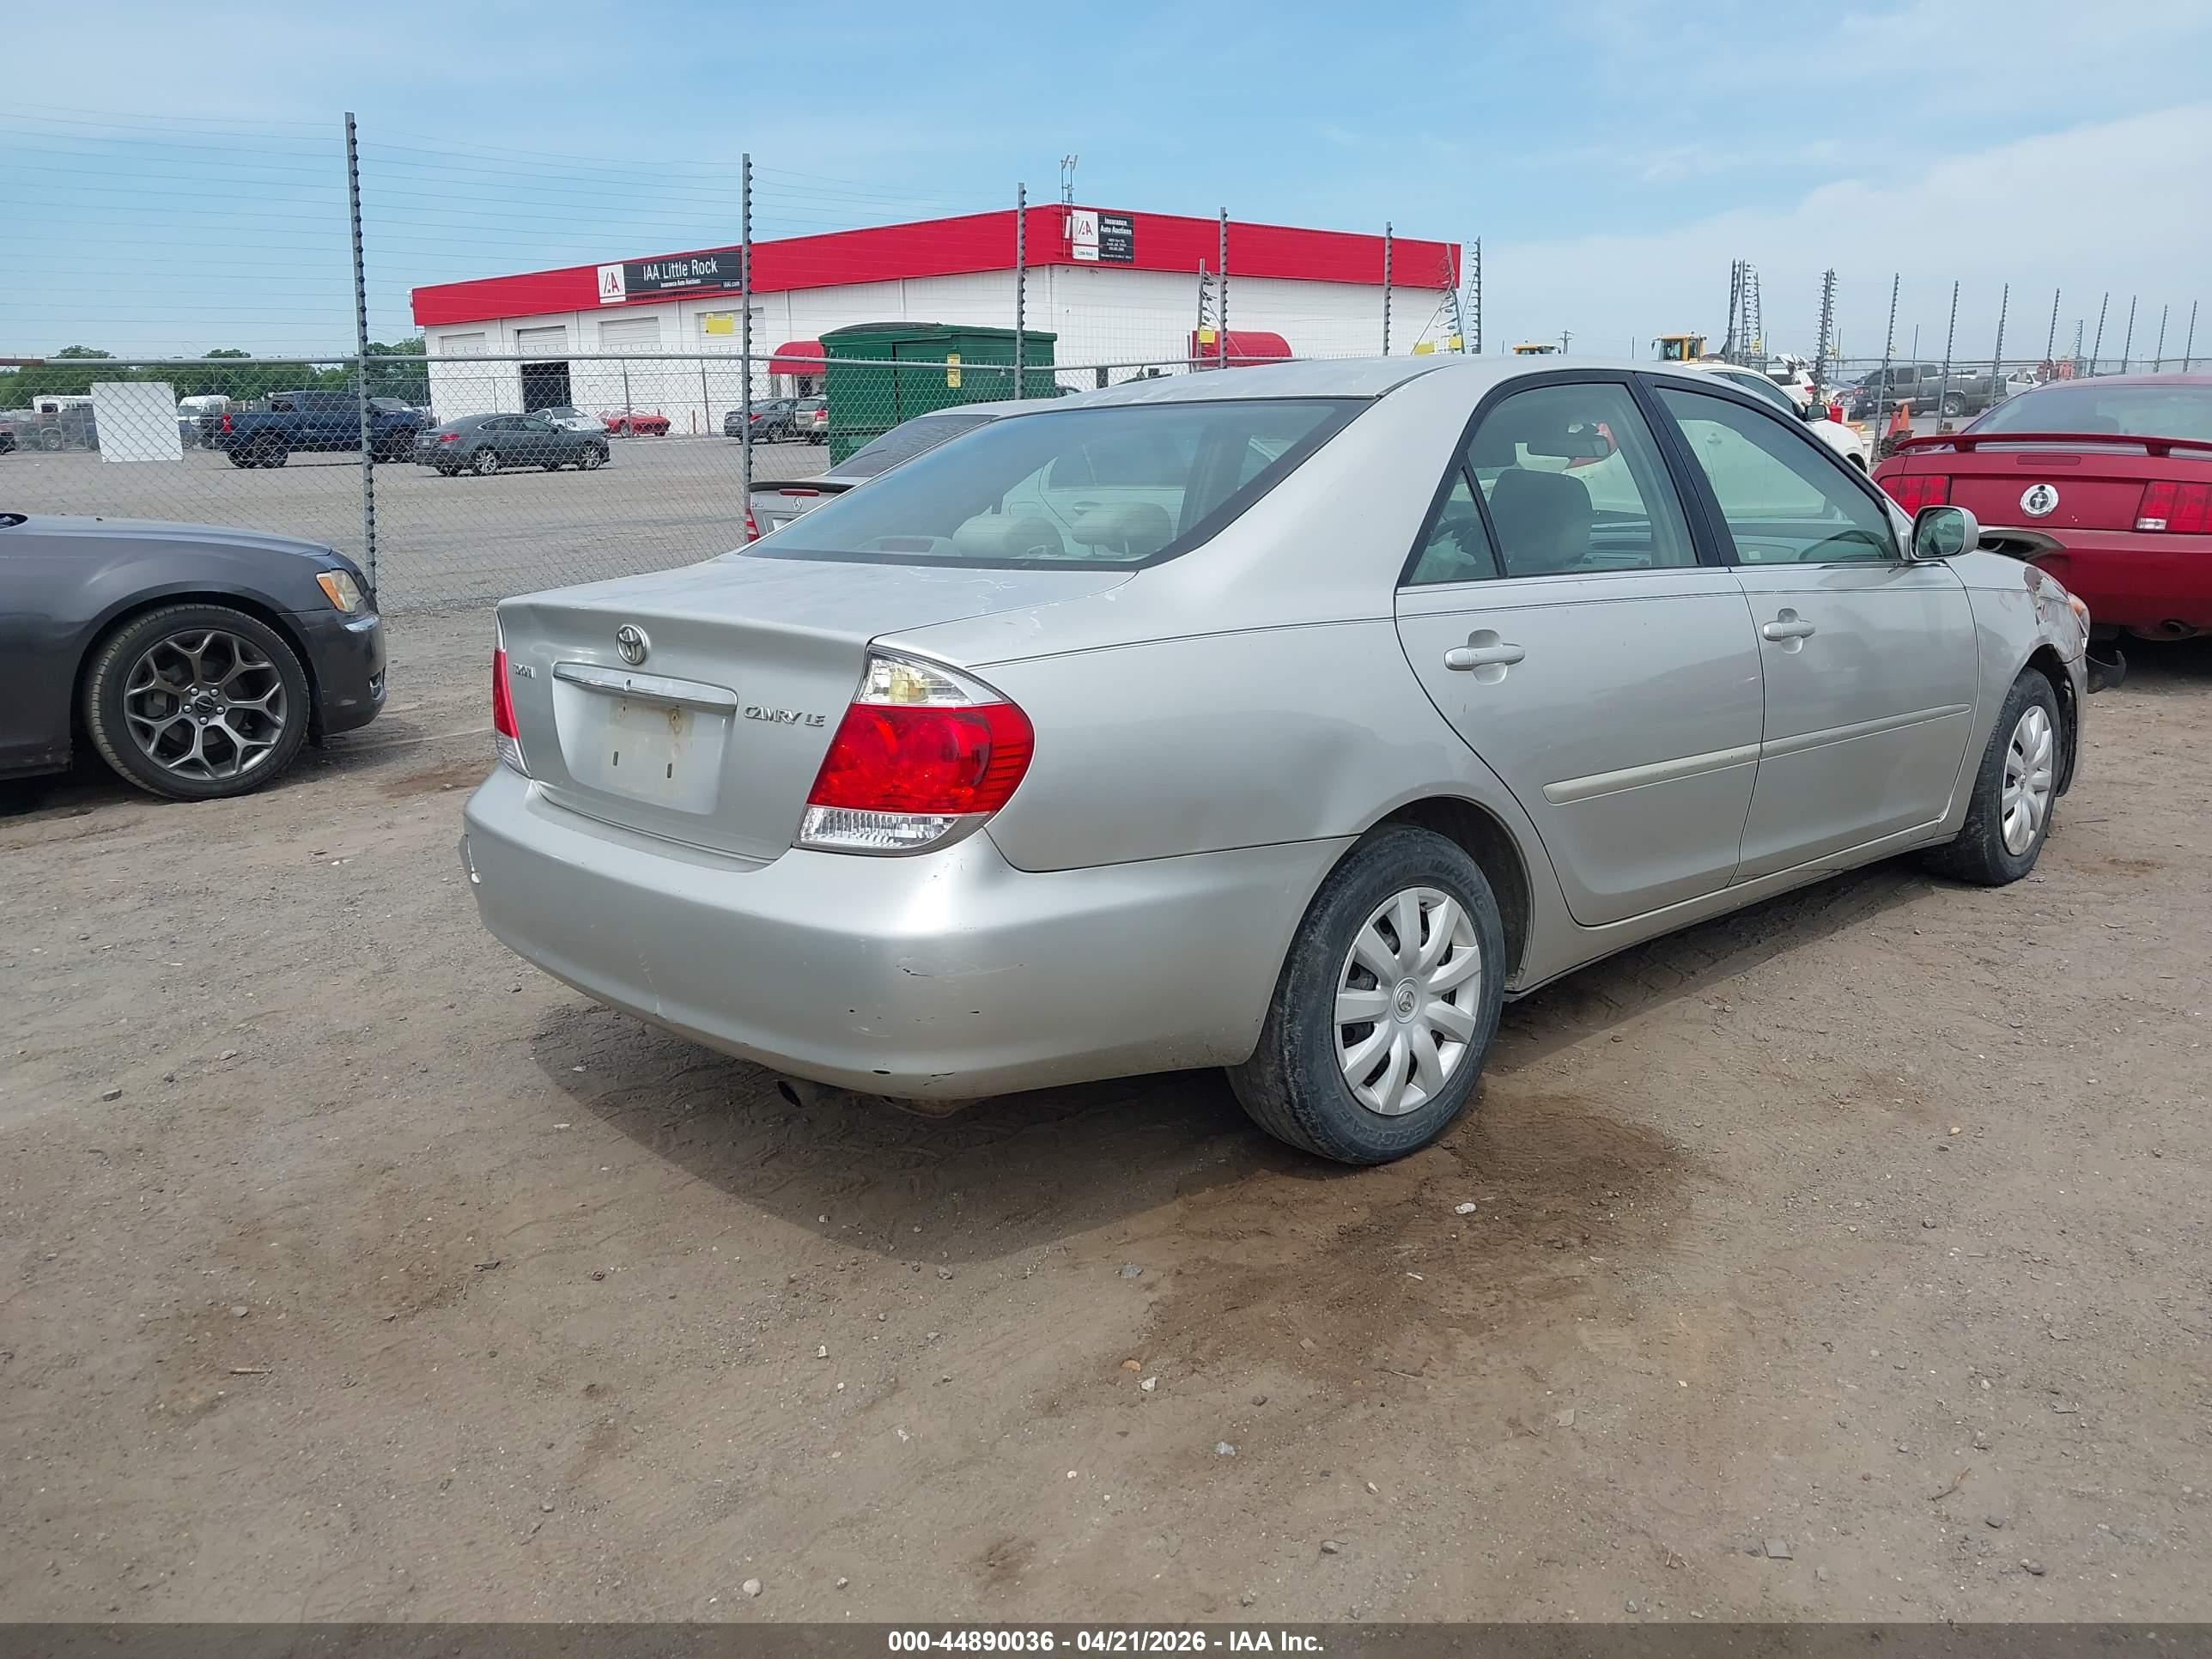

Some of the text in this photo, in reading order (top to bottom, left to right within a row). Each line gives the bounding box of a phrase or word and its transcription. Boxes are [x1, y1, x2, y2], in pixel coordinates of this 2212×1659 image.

[1104, 216, 1127, 226] Insurance
[1112, 226, 1132, 234] Auctions
[643, 257, 718, 282] IAA Little Rock
[744, 706, 826, 727] CAMRY LE
